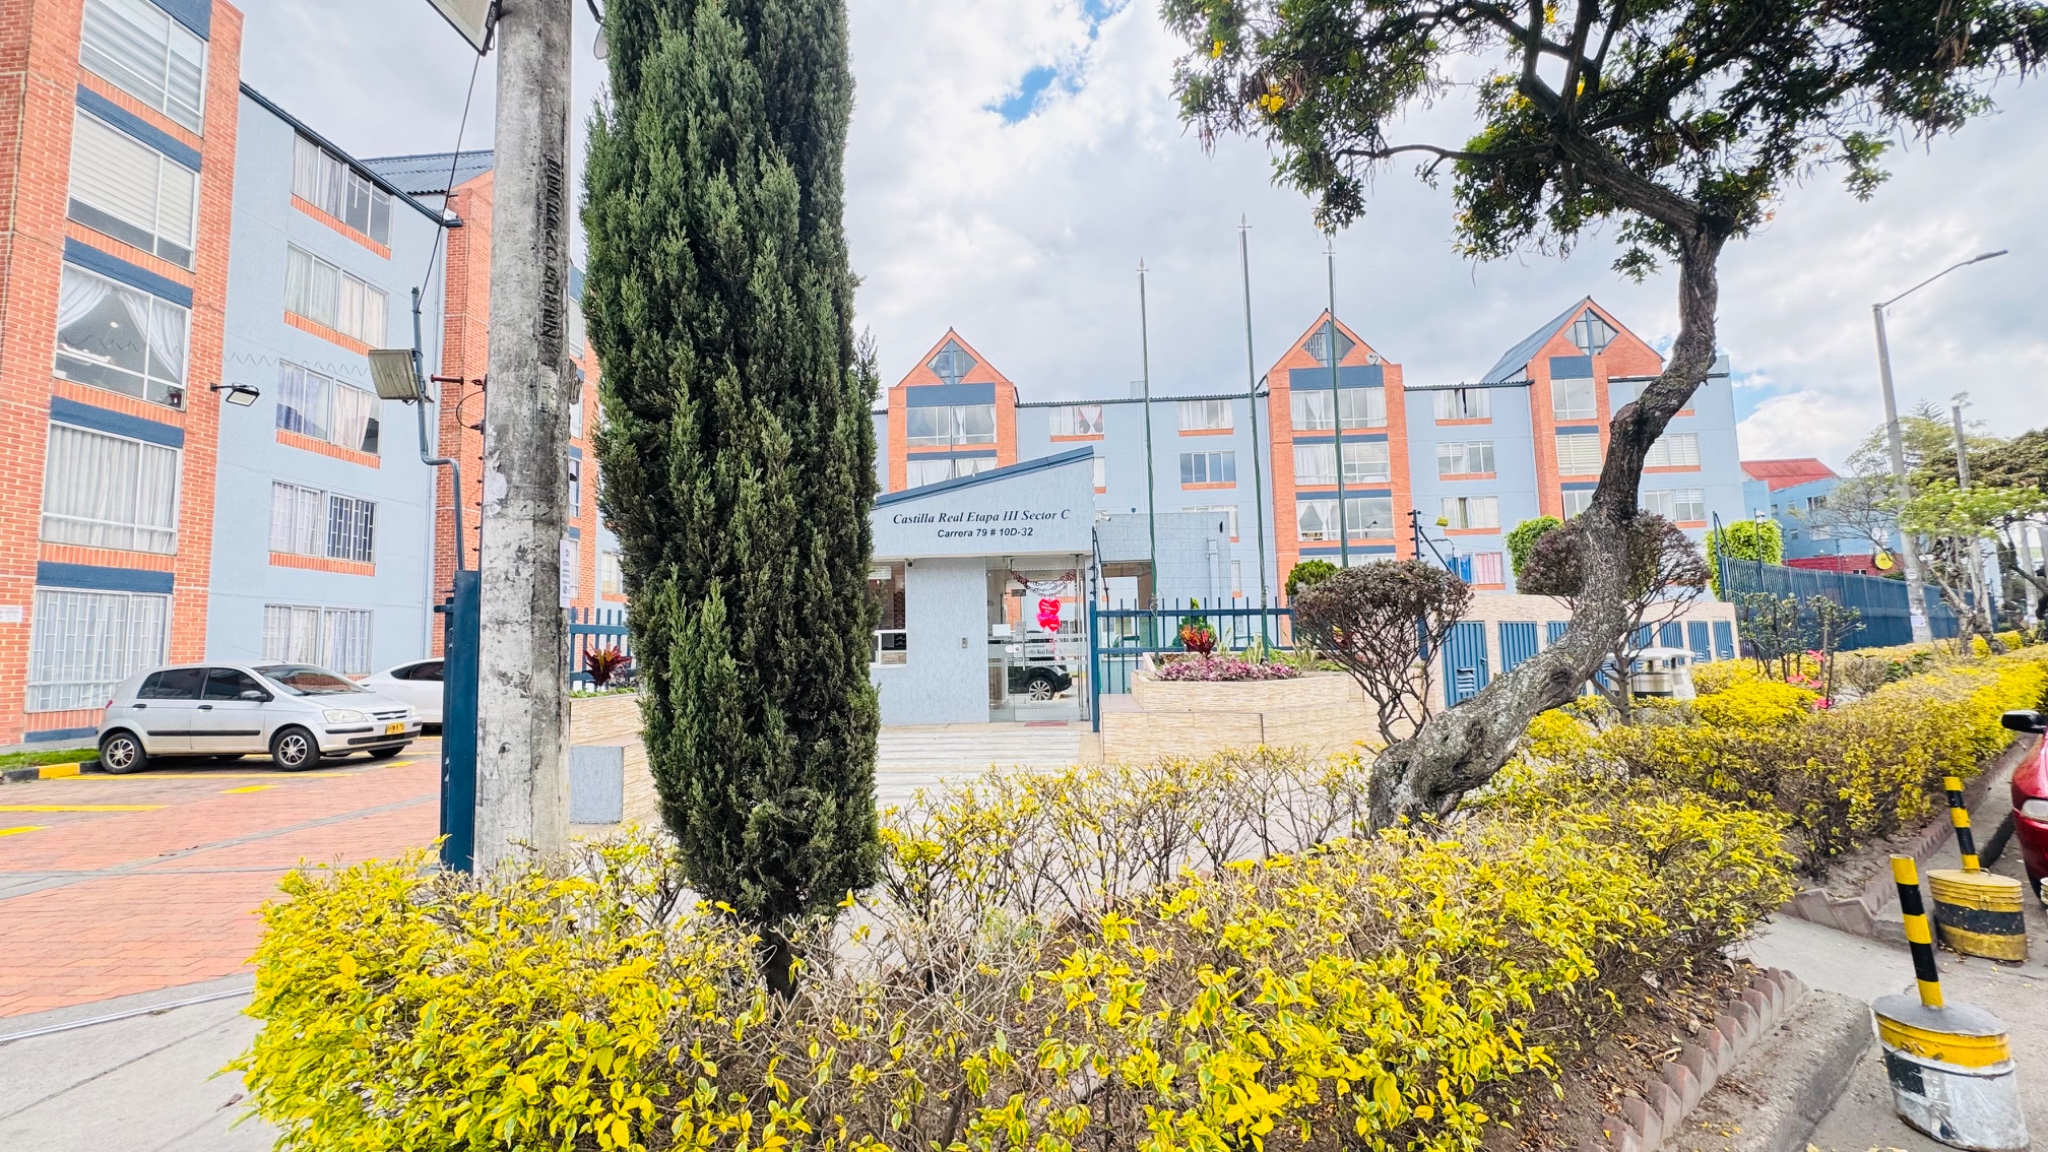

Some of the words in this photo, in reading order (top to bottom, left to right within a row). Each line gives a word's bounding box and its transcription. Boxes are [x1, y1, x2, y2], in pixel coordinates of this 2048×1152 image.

[893, 513, 935, 525] Castilla
[938, 512, 964, 523] Real
[966, 511, 1000, 524] Etapa
[1002, 510, 1019, 522] III
[1021, 508, 1058, 521] Sector
[1060, 508, 1071, 520] C
[937, 529, 973, 538] Carrera
[976, 528, 988, 537] 79
[990, 528, 996, 536] #
[999, 526, 1034, 537] 10D-32
